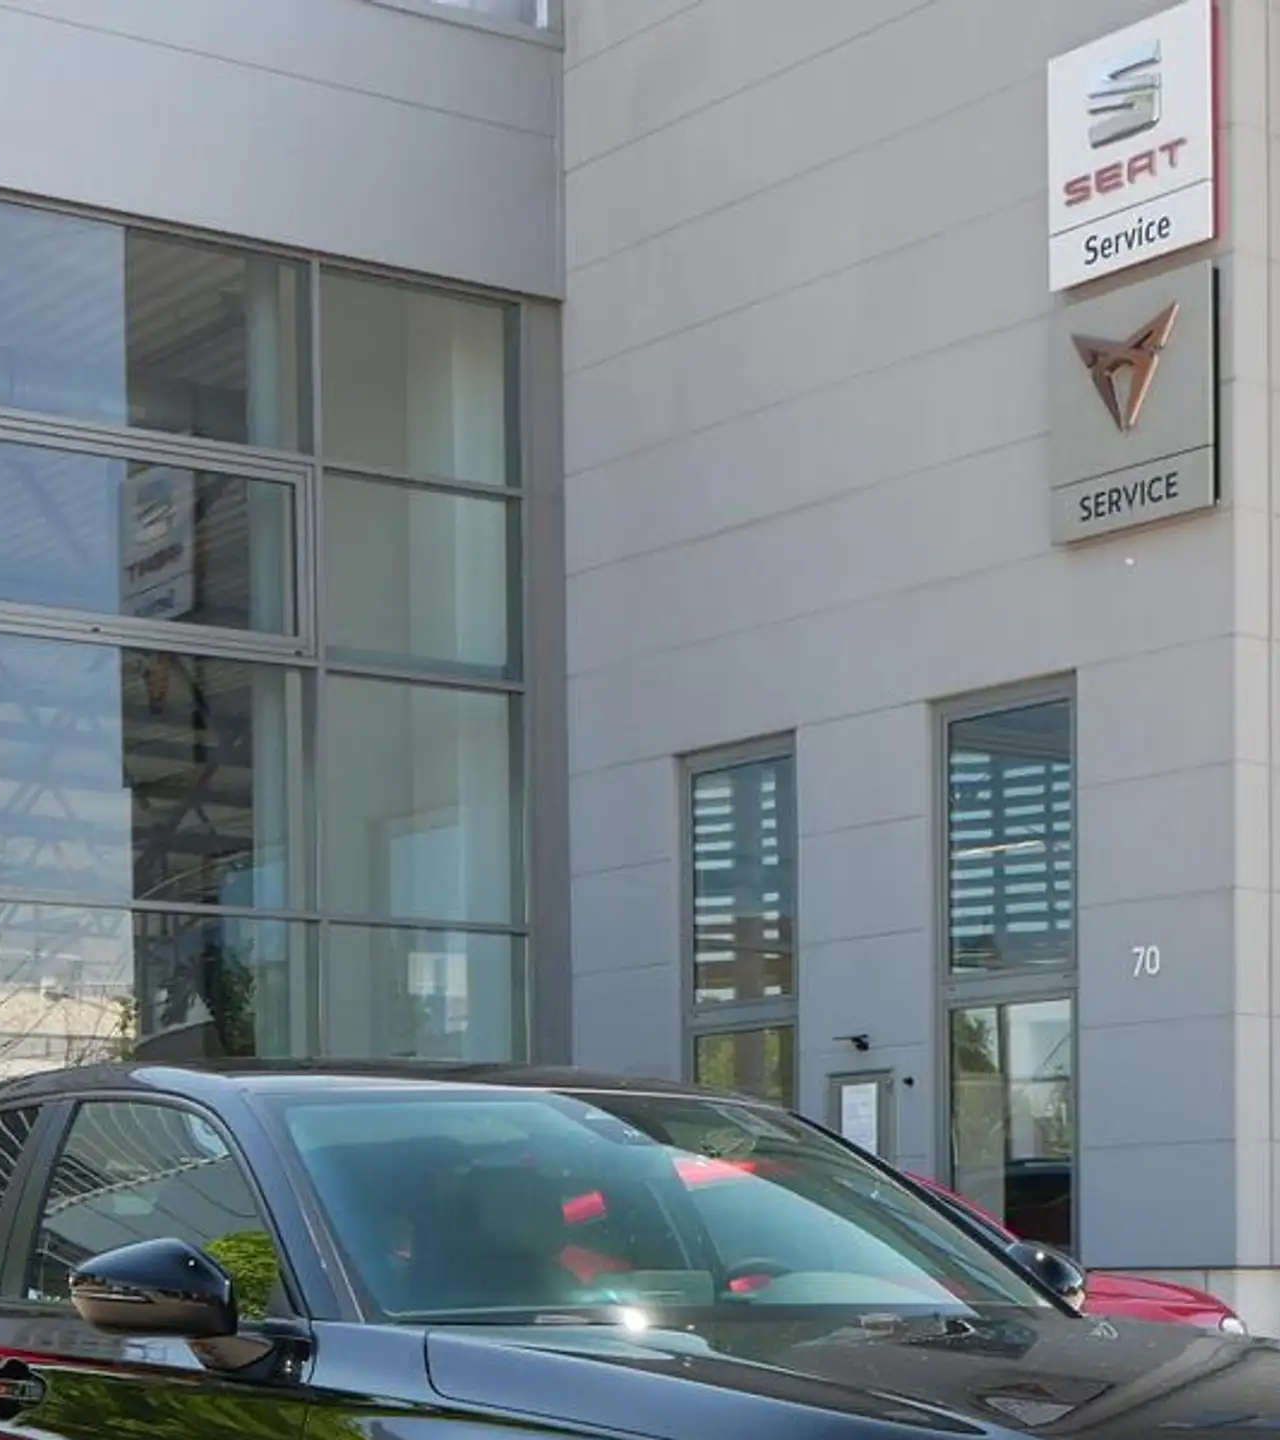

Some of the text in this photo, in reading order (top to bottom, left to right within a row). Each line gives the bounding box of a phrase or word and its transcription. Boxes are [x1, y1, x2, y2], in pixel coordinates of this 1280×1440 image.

[1063, 137, 1188, 208] SEAT
[1083, 216, 1170, 266] Service
[1079, 471, 1179, 521] SERVICE
[1131, 945, 1160, 977] 70
